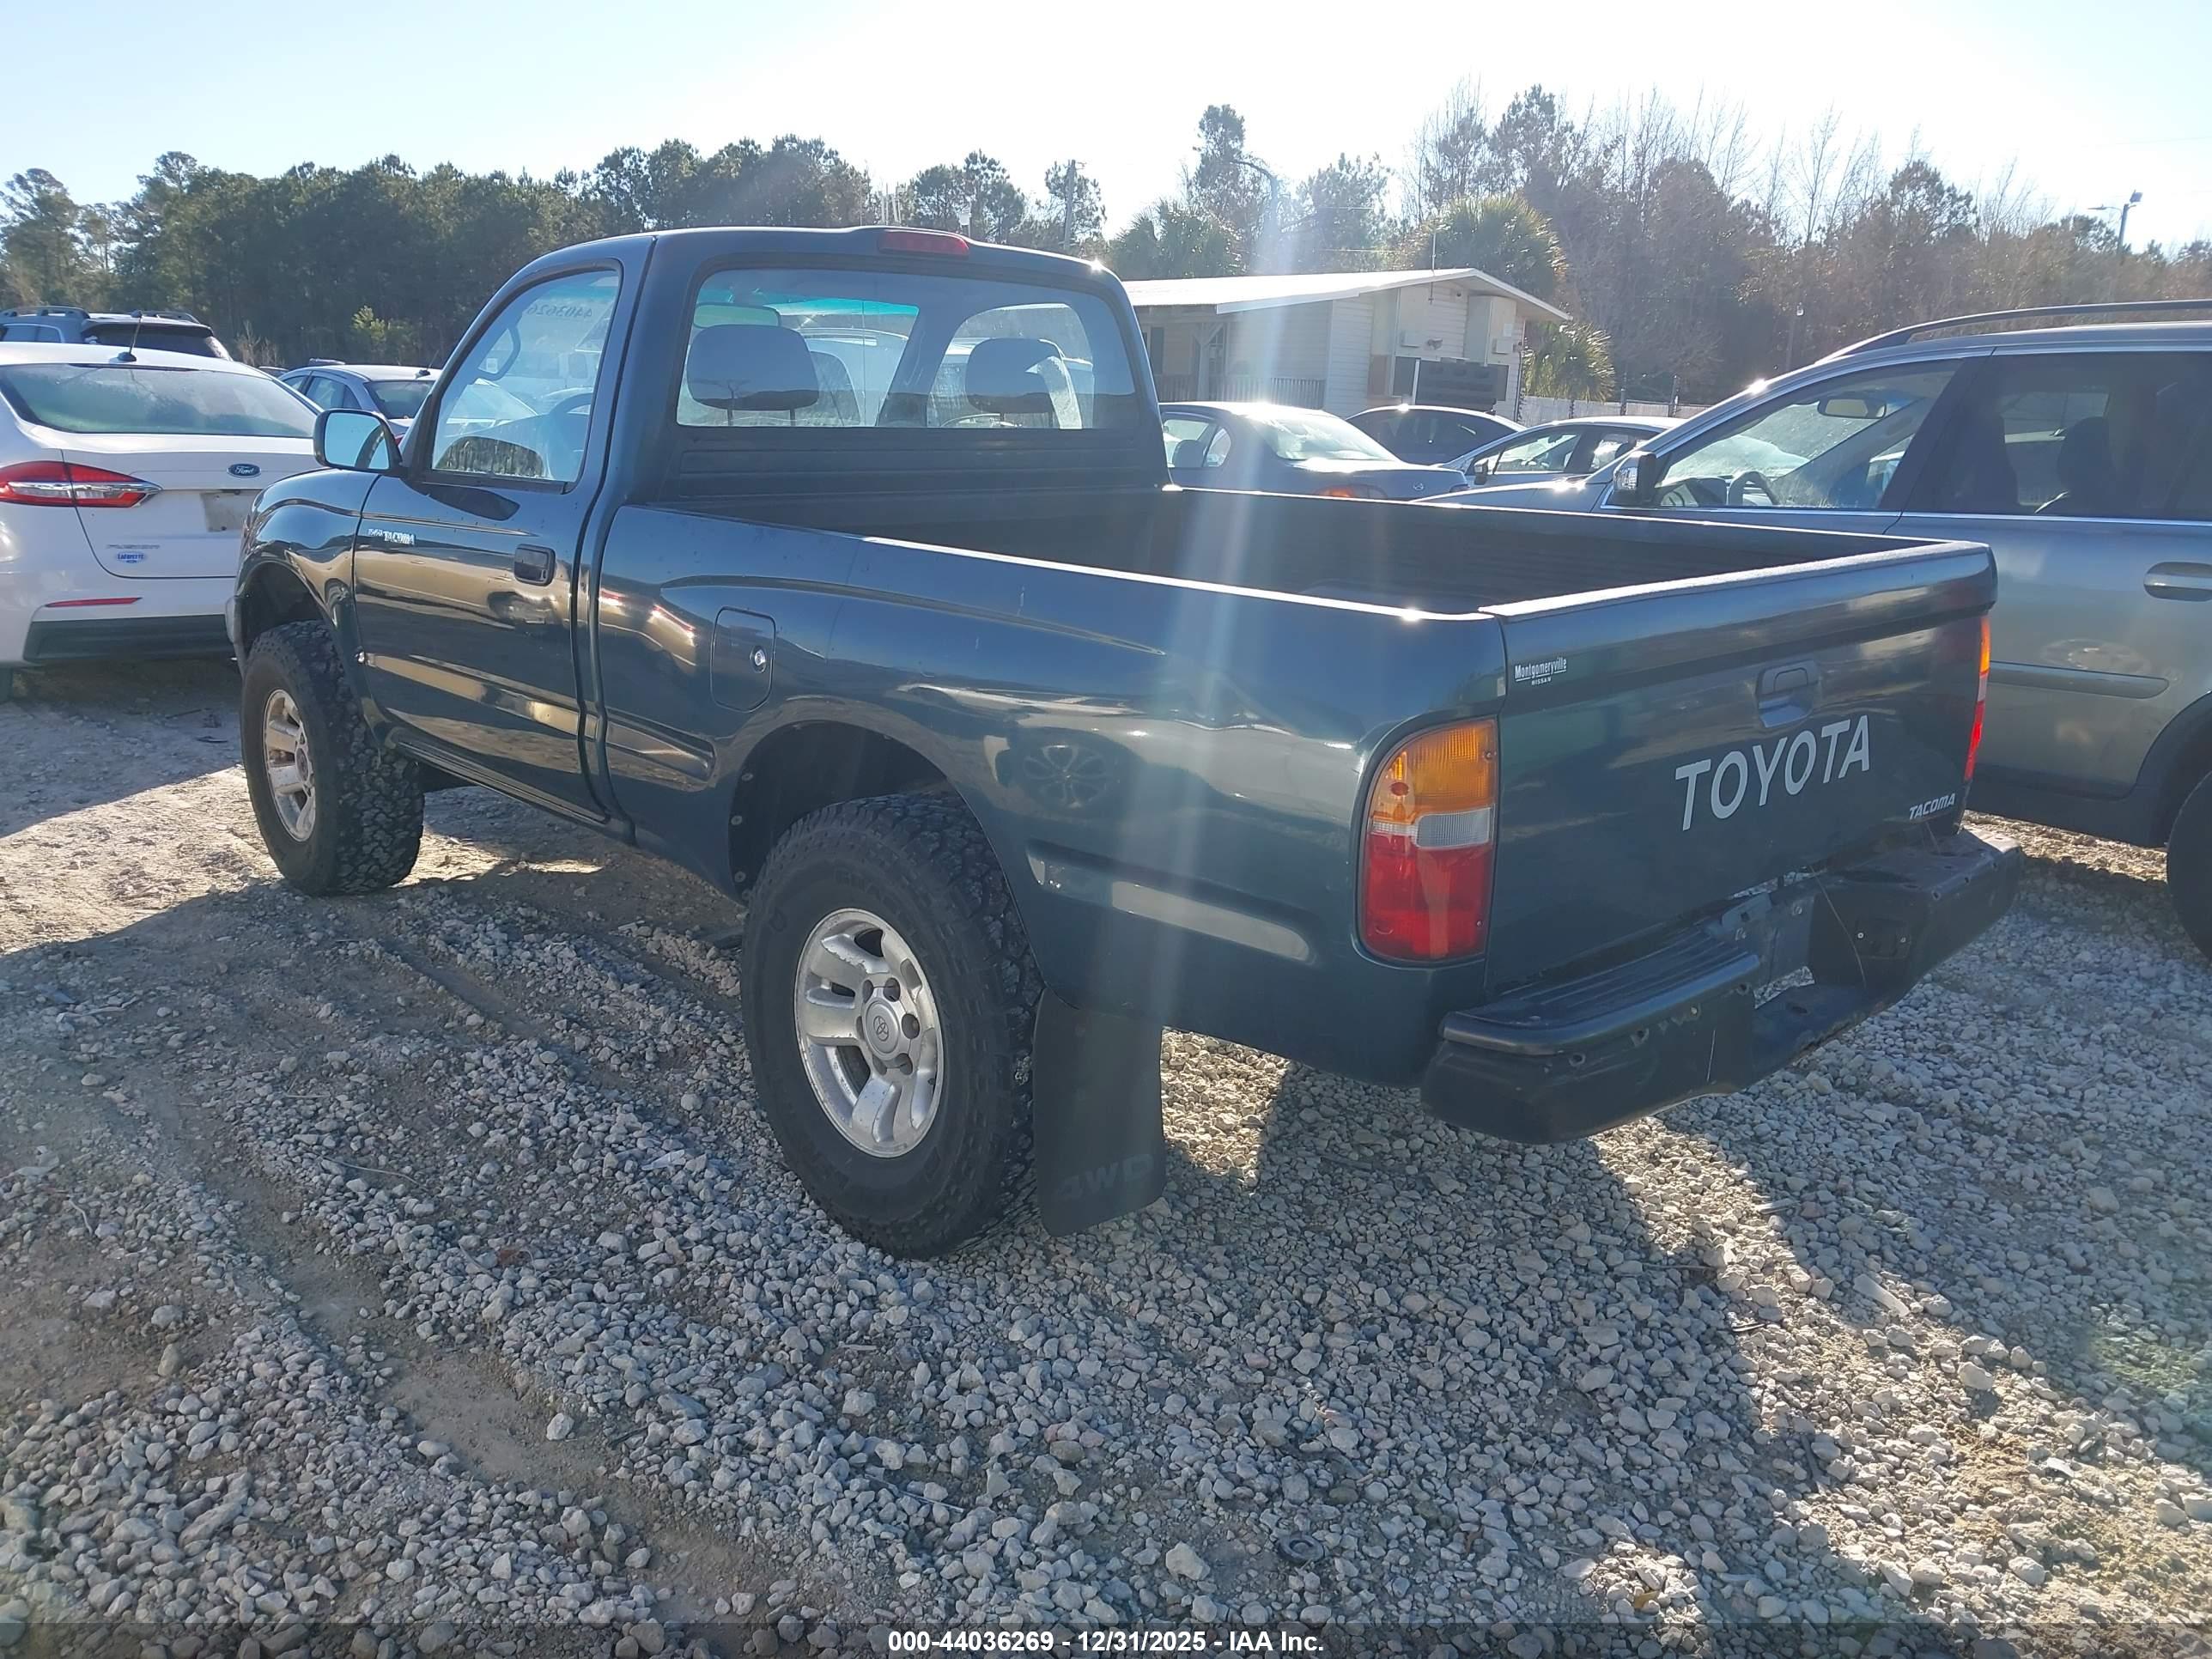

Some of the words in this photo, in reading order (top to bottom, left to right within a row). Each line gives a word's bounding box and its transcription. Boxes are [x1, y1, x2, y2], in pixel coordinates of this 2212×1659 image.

[383, 531, 415, 545] TACOMA
[1514, 657, 1567, 678] Montgomeryville
[1675, 715, 1870, 831] TOYOTA
[1908, 793, 1956, 820] TACOMA
